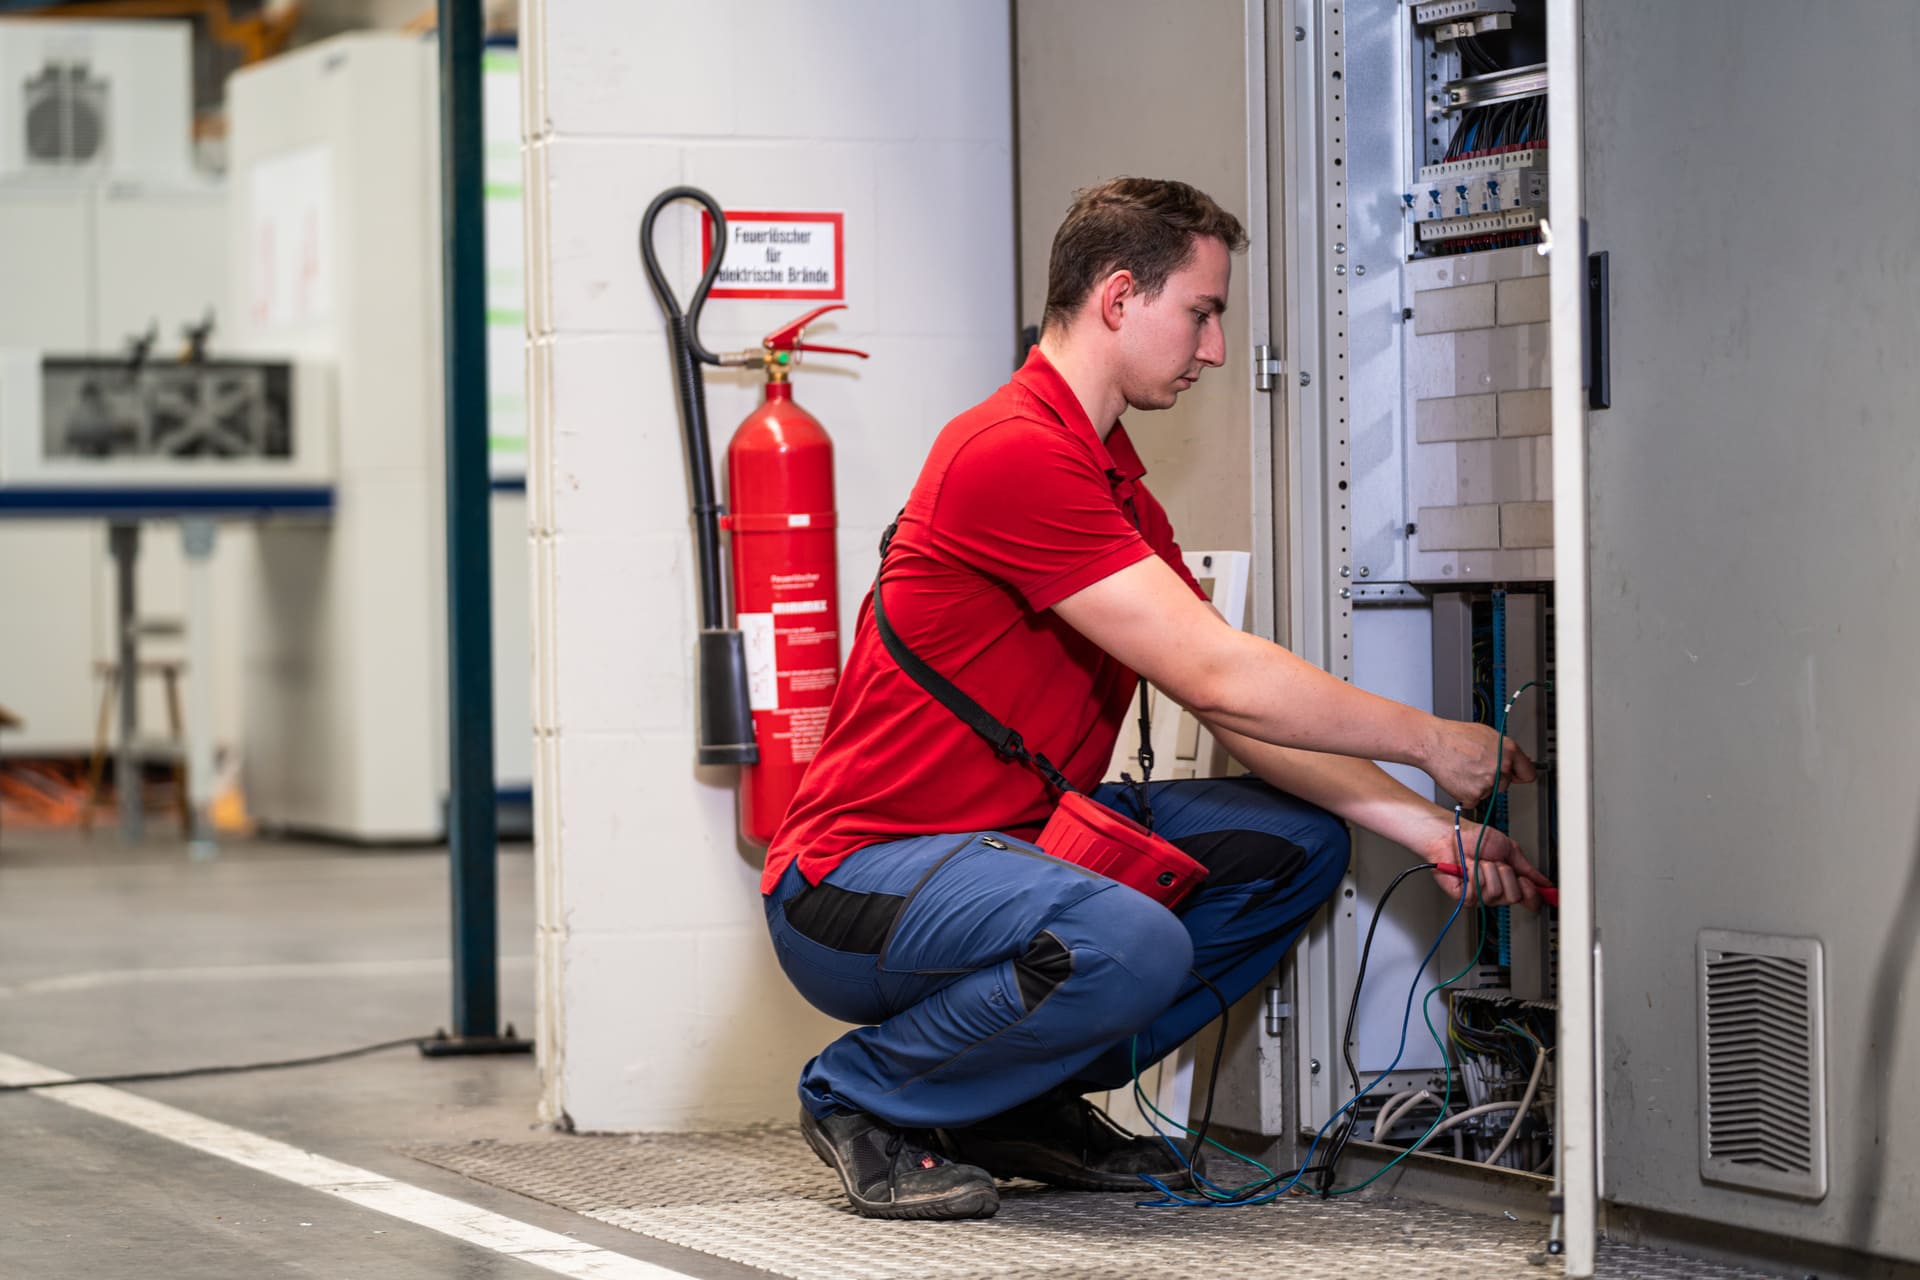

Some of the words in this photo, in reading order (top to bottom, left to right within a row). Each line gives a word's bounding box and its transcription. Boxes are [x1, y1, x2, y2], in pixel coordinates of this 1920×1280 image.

[735, 227, 812, 243] Feuerlöscher
[766, 248, 781, 262] für
[788, 268, 829, 283] Brände
